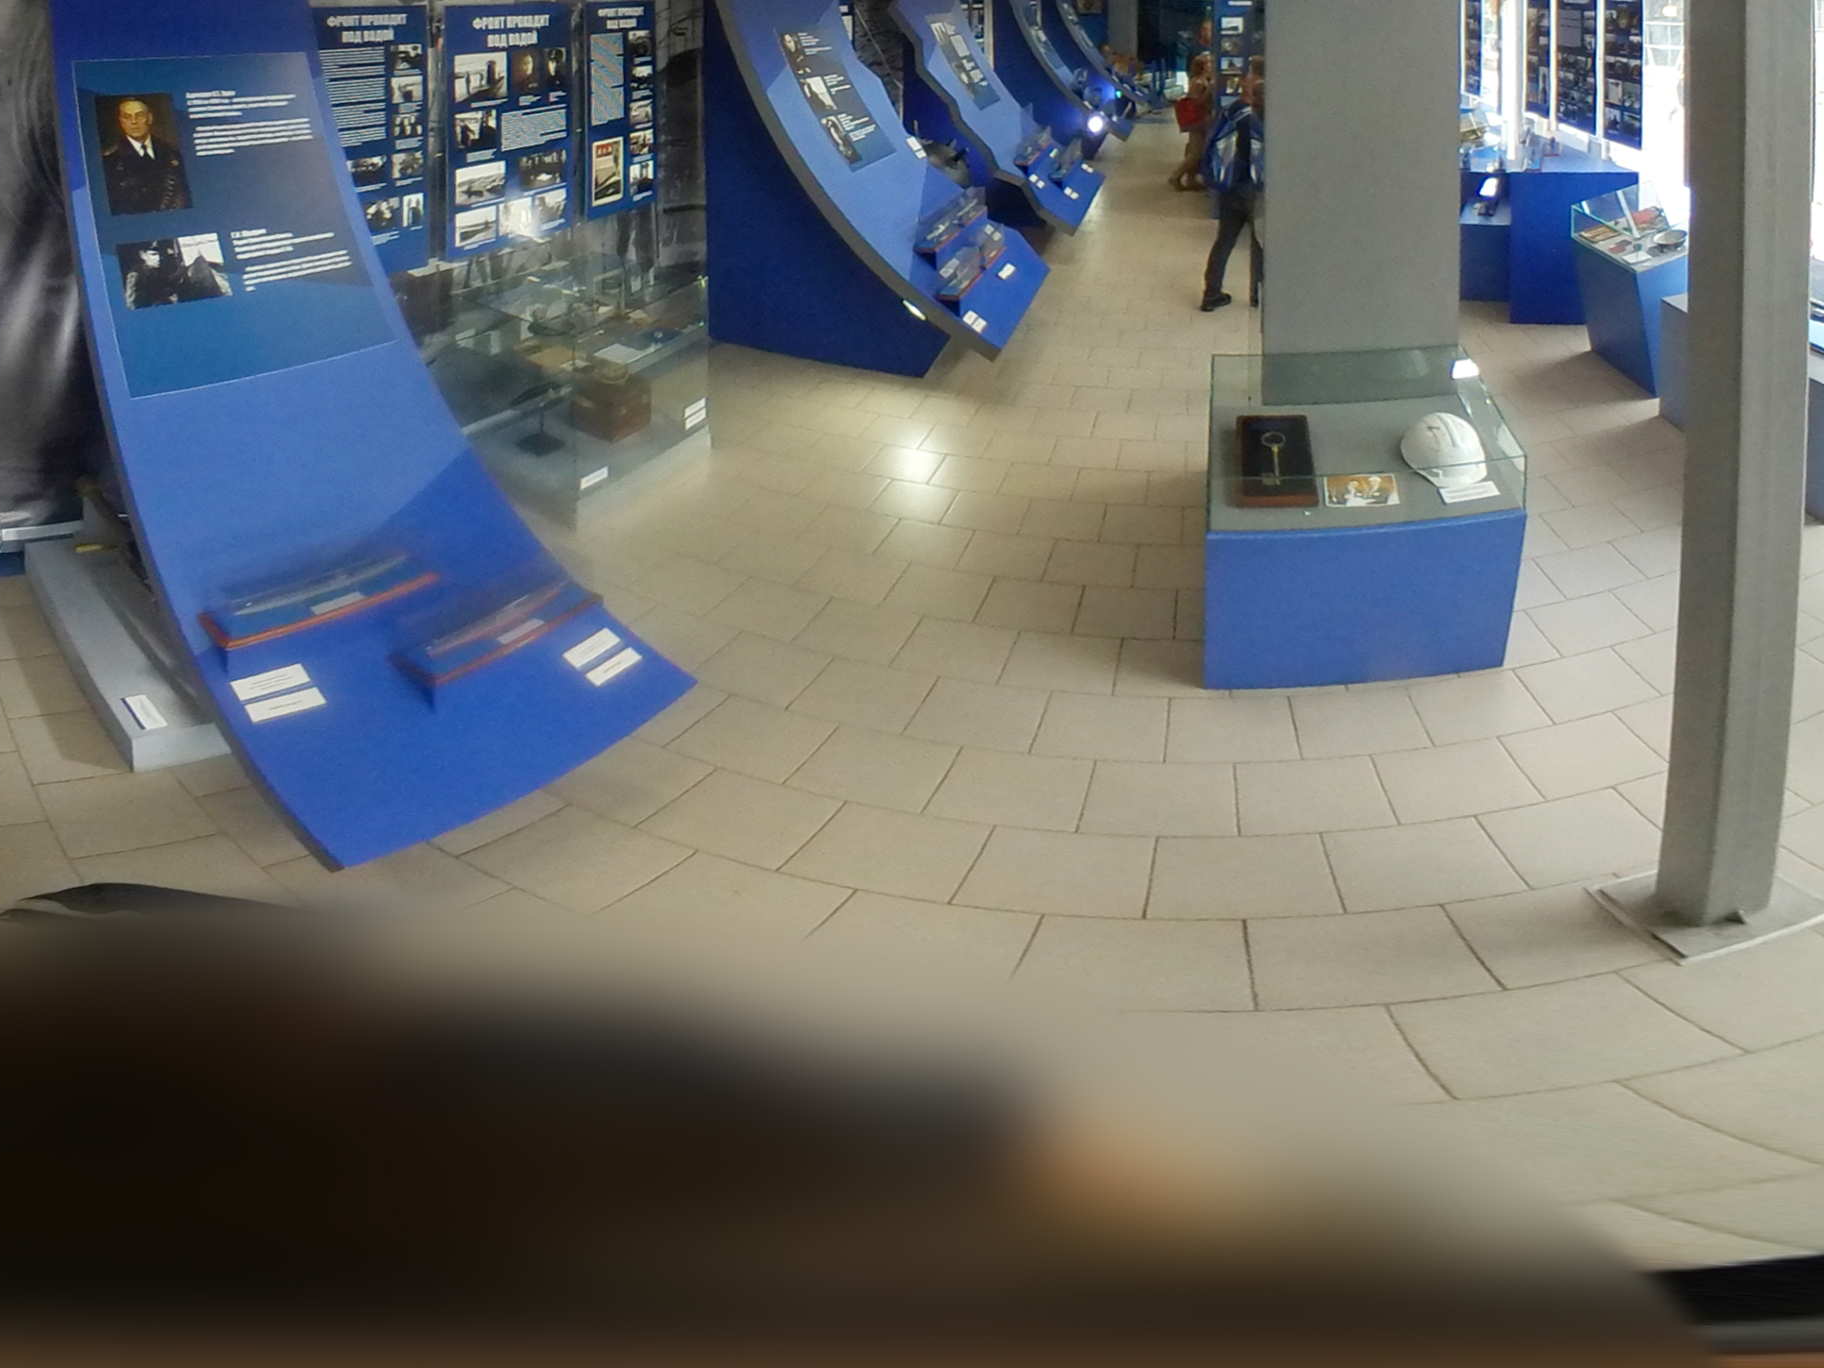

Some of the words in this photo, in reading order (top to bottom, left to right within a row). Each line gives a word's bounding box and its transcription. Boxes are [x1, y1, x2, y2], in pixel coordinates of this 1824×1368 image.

[326, 15, 360, 28] ФРОНТ
[361, 13, 408, 26] ПРОХОДИТ
[472, 16, 506, 30] ФРОНТ
[506, 14, 551, 29] ПРОХОДИТ
[341, 30, 363, 44] ПОД
[363, 26, 395, 43] ВОДОЙ
[487, 33, 509, 48] ПОД
[508, 29, 538, 47] ВОДОЙ
